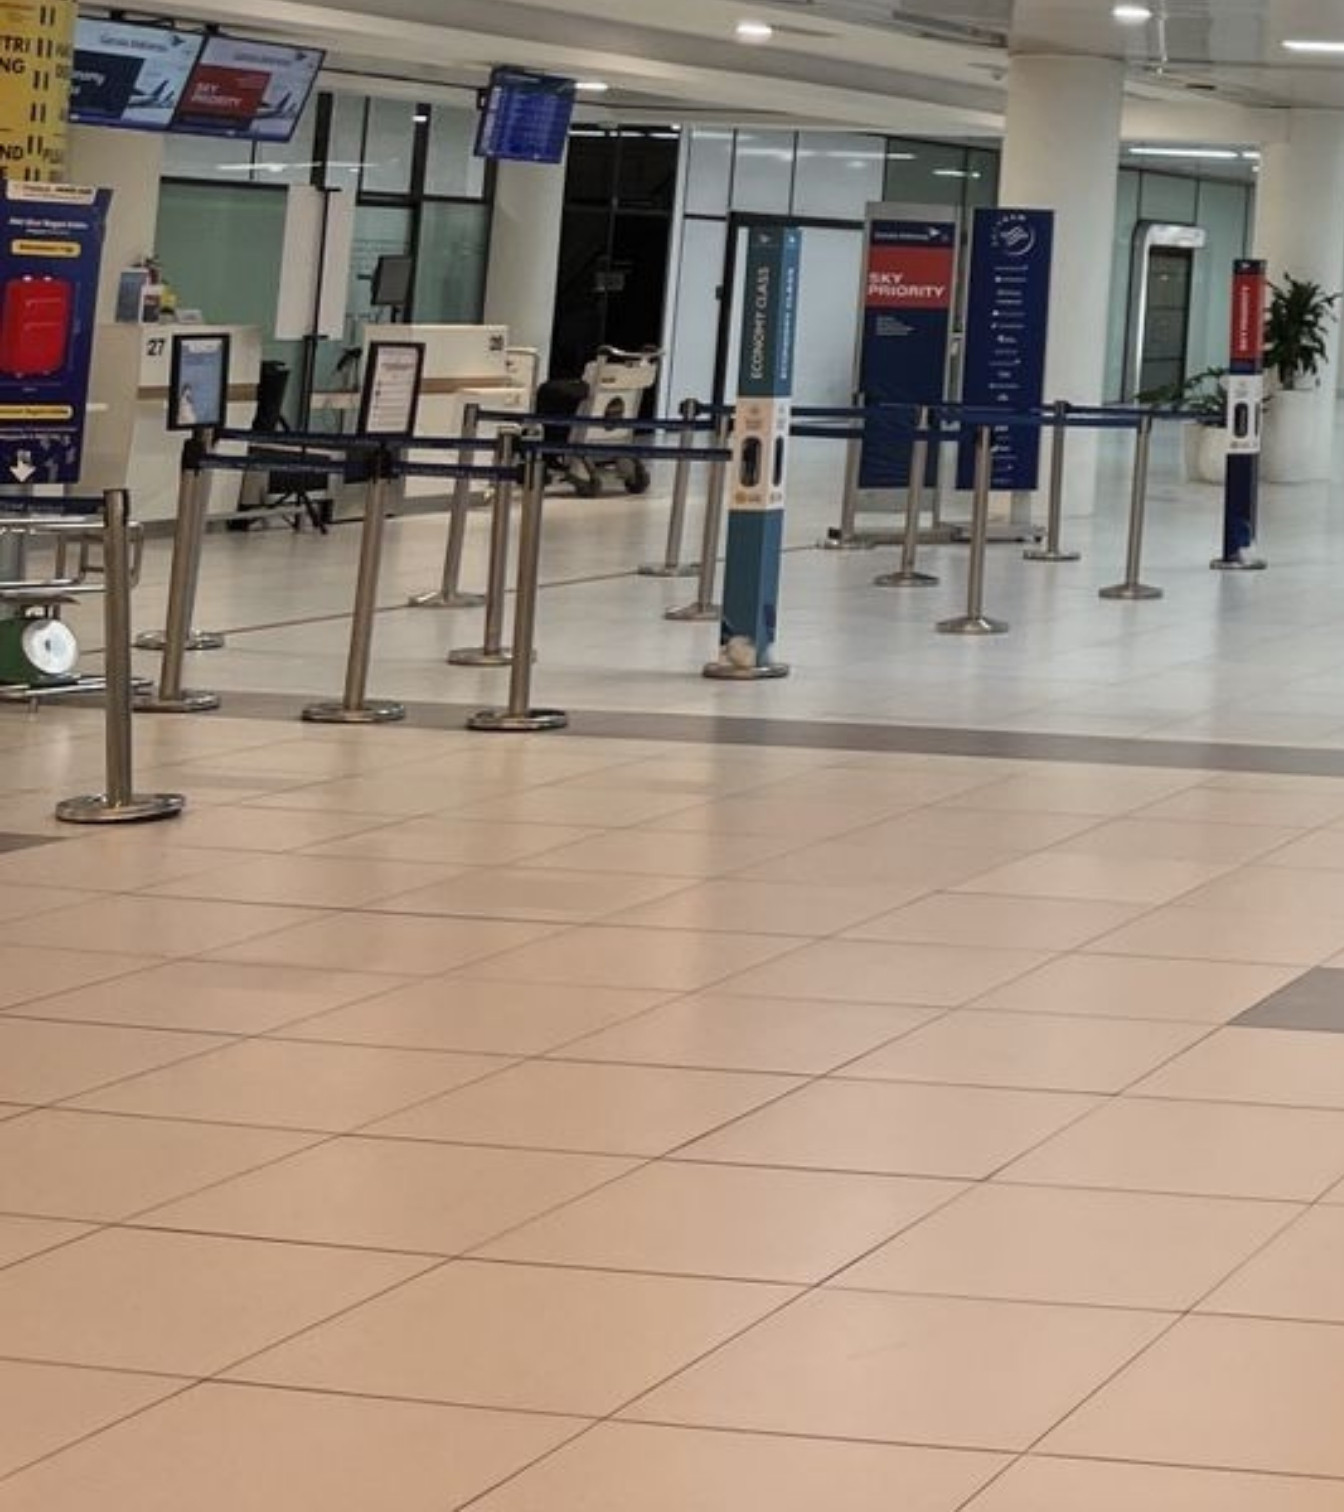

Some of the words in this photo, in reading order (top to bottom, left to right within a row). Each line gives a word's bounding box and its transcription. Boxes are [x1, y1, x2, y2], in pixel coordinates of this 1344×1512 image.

[868, 271, 903, 284] SKY
[868, 284, 945, 298] PRIORITY
[147, 339, 165, 356] 27
